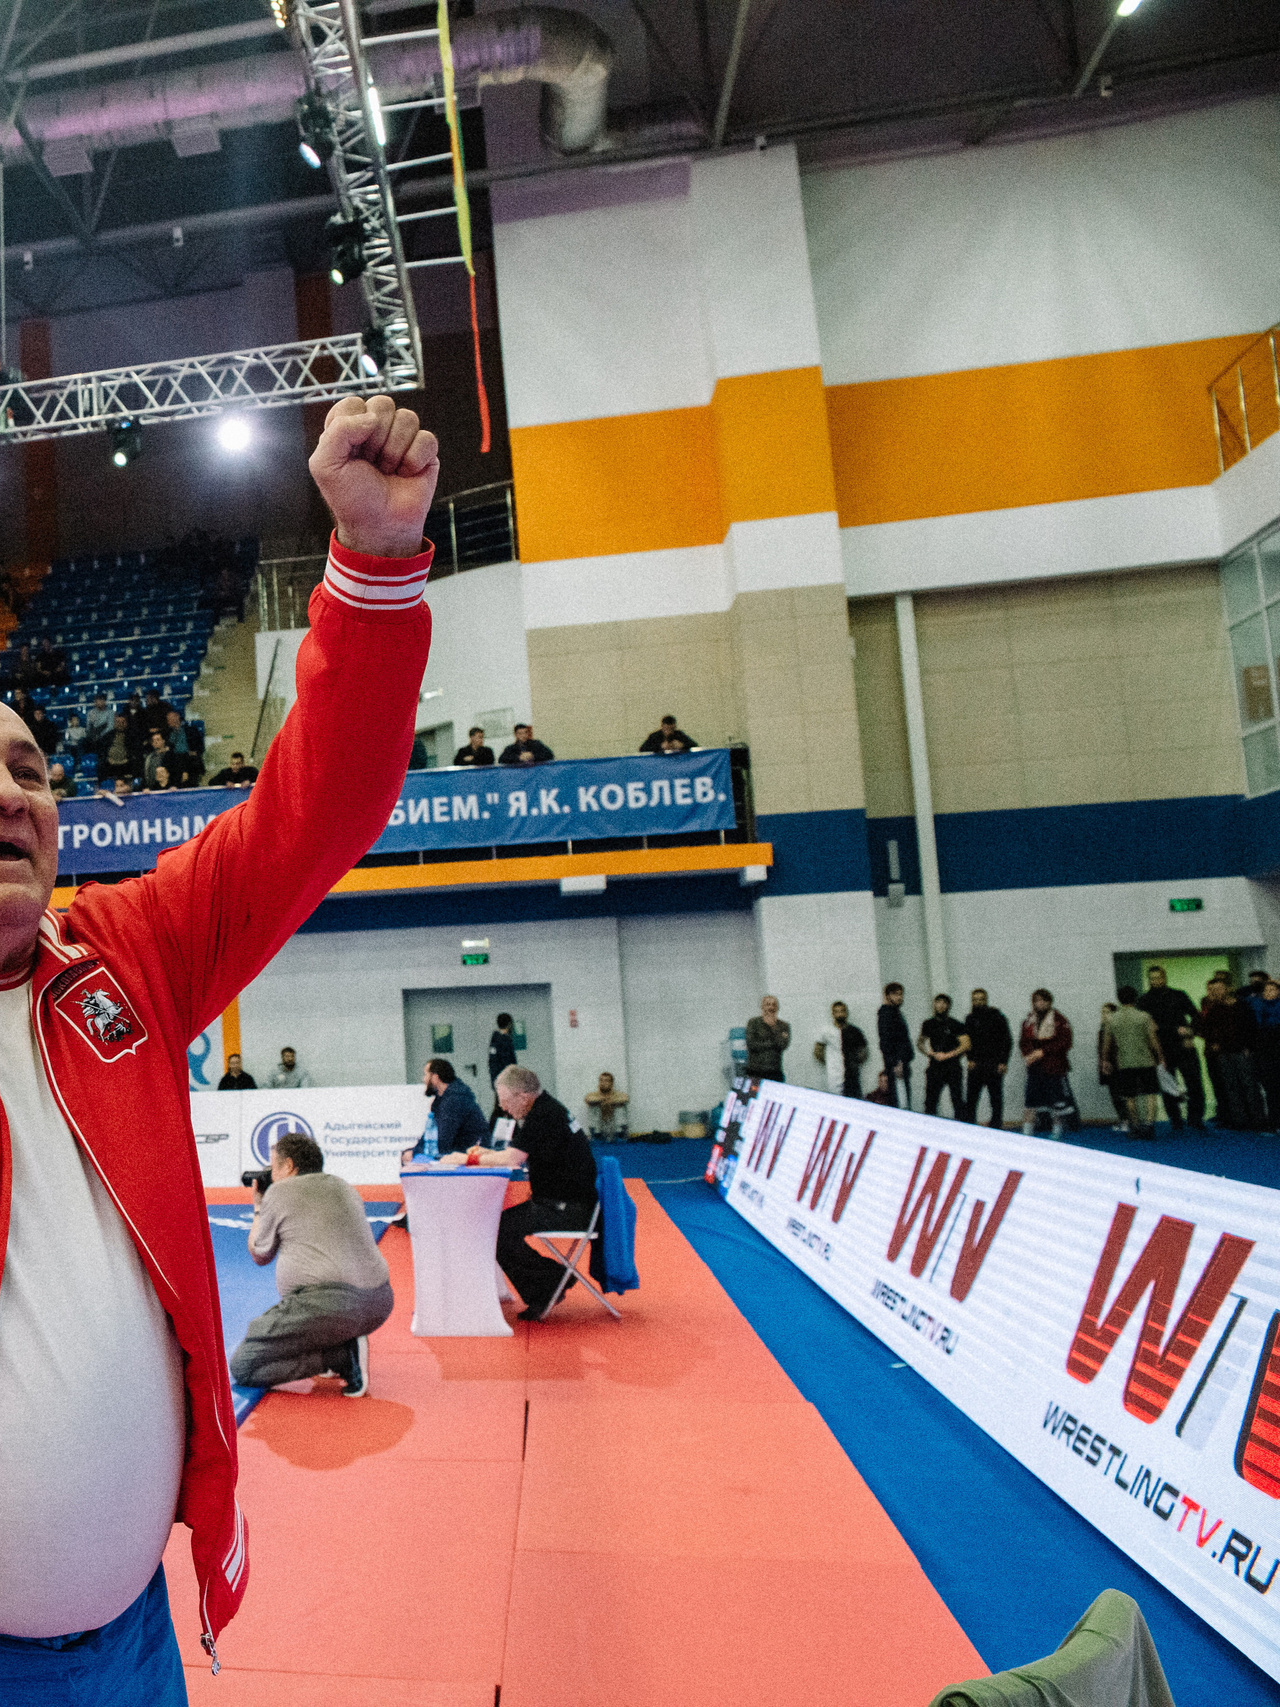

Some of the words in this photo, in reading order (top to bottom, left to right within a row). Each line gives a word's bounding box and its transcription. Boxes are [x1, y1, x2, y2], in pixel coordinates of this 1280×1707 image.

[507, 787, 570, 818] Я.К.
[578, 776, 726, 812] КОБЛЕВ.
[323, 1149, 400, 1159] Университе
[1042, 1400, 1280, 1596] WRESTLINGTV.RU
